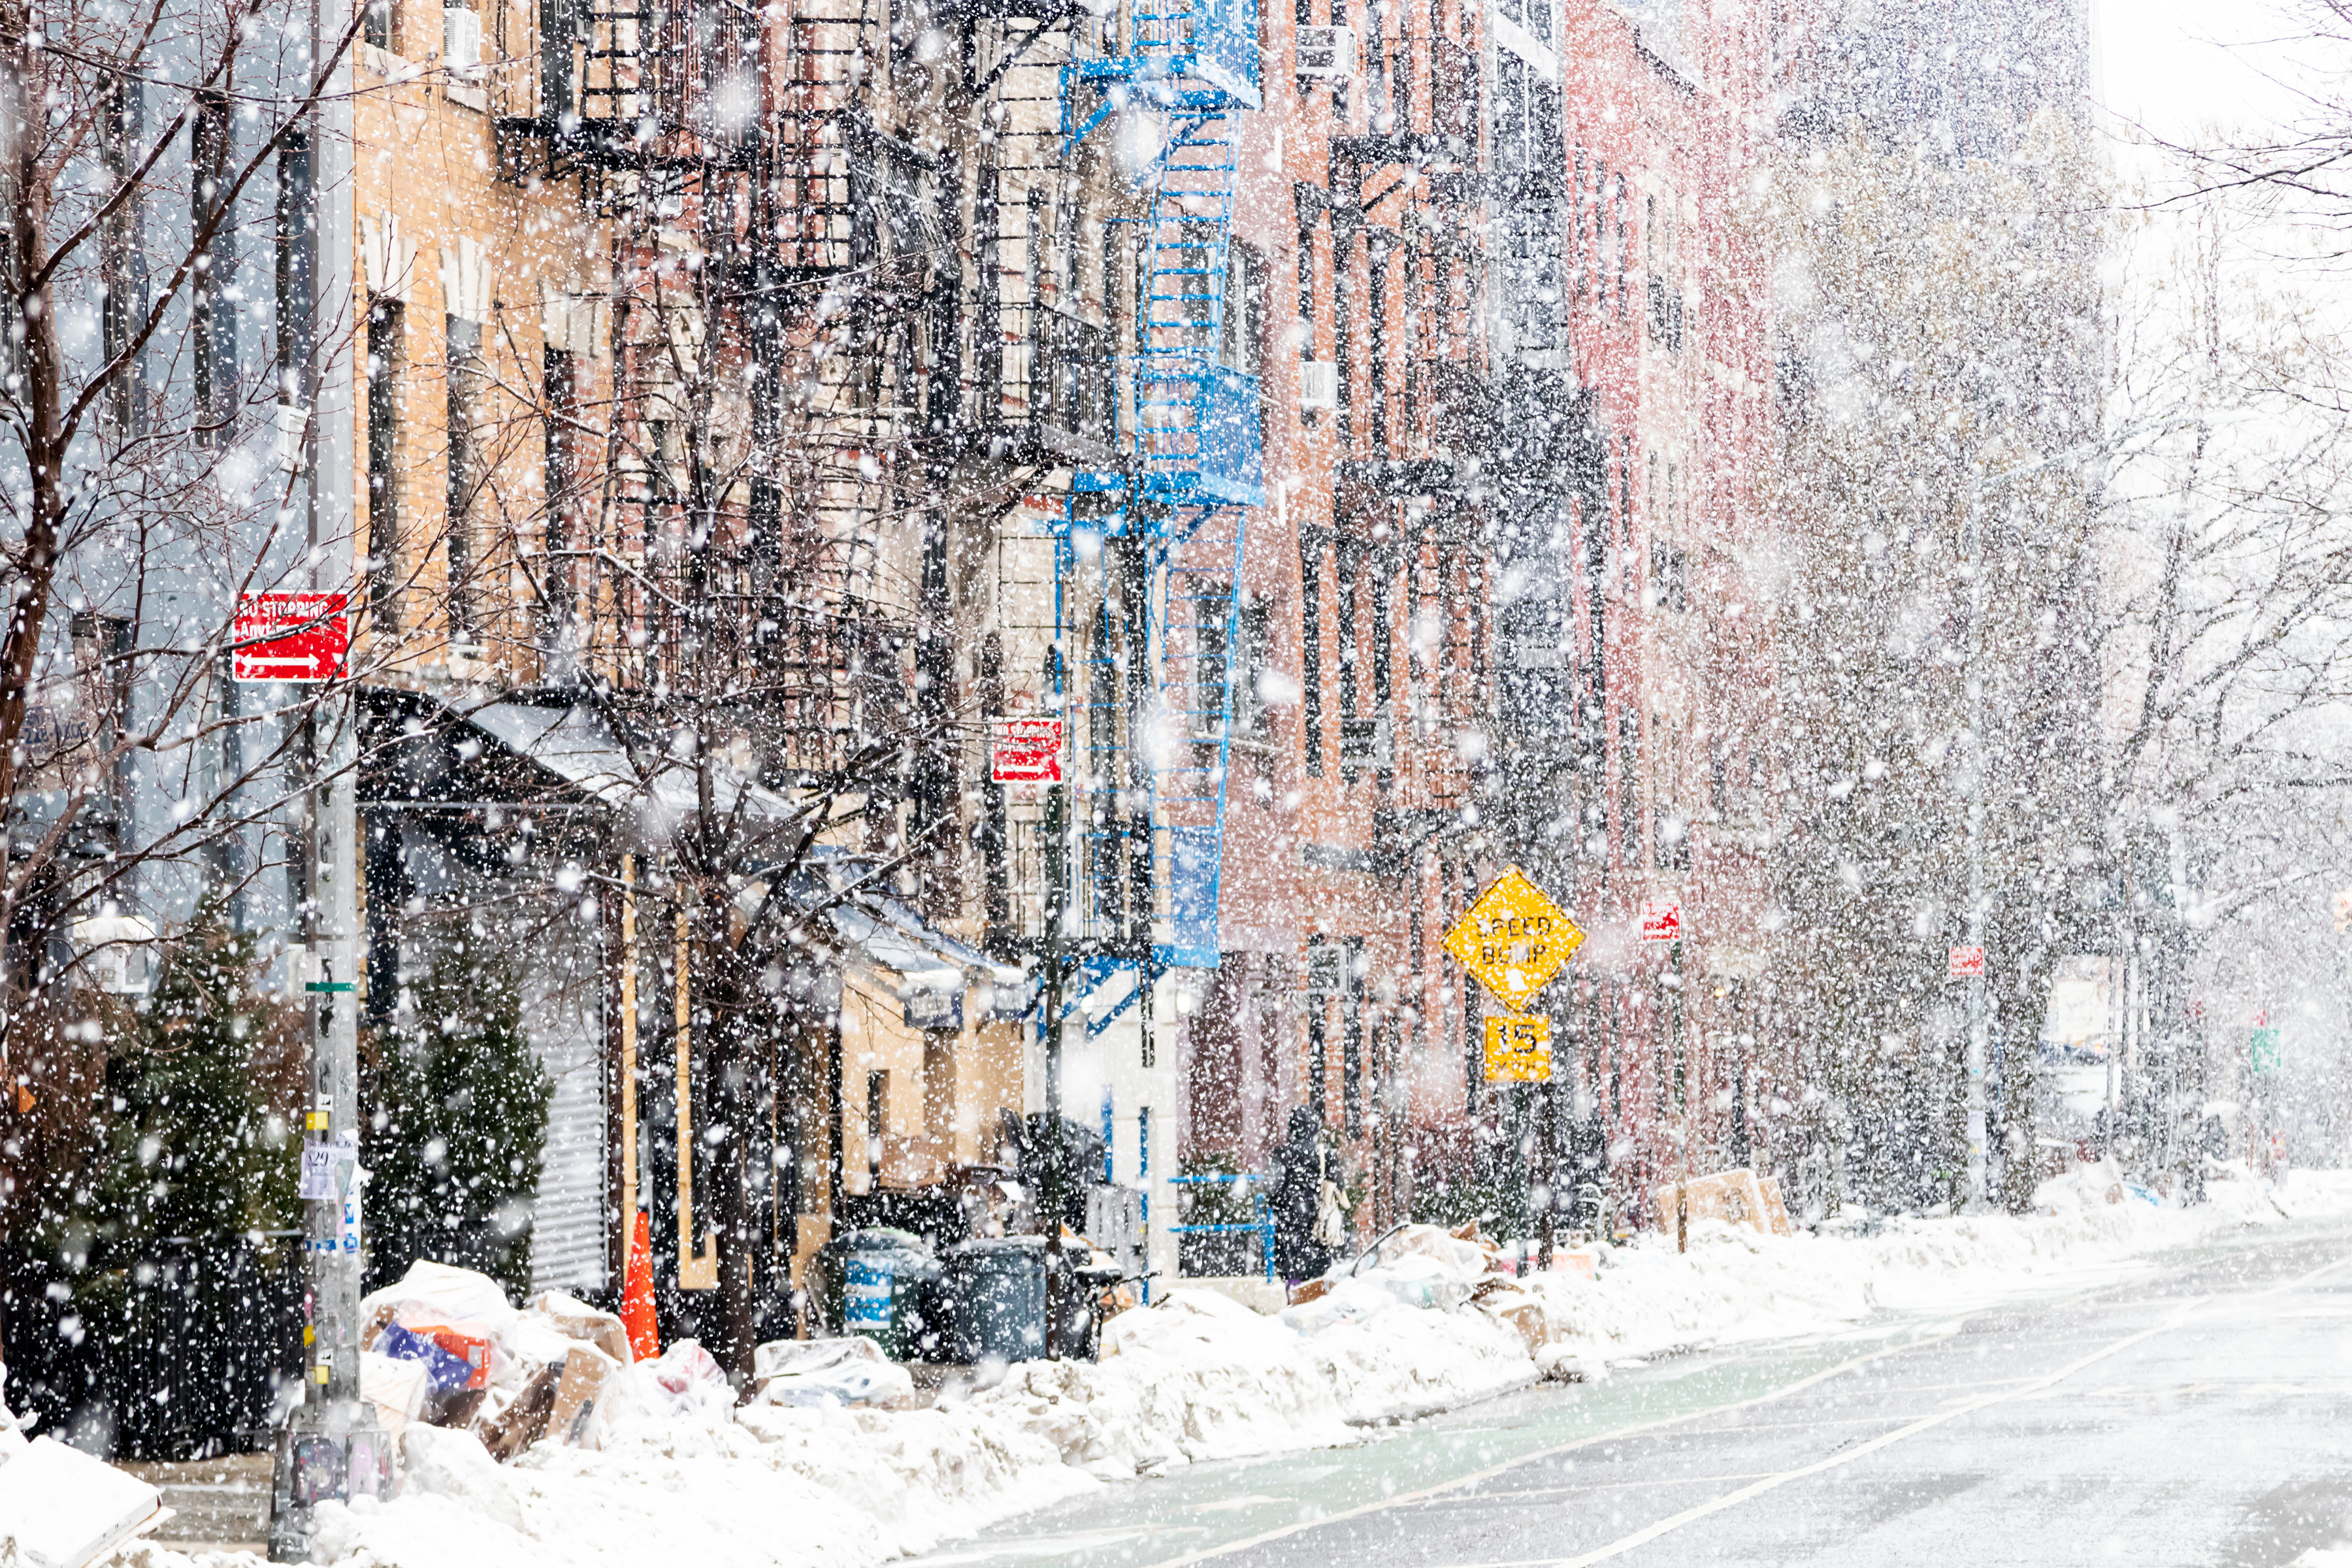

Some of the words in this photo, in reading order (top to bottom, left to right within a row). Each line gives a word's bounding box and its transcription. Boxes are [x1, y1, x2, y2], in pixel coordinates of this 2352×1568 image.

[239, 602, 258, 617] NO
[262, 601, 329, 617] STOPPING
[241, 621, 299, 638] Anytm
[1477, 917, 1551, 937] SPEED
[1482, 944, 1546, 964] BUMP
[1497, 1024, 1537, 1054] 15
[1496, 1061, 1536, 1072] MPH
